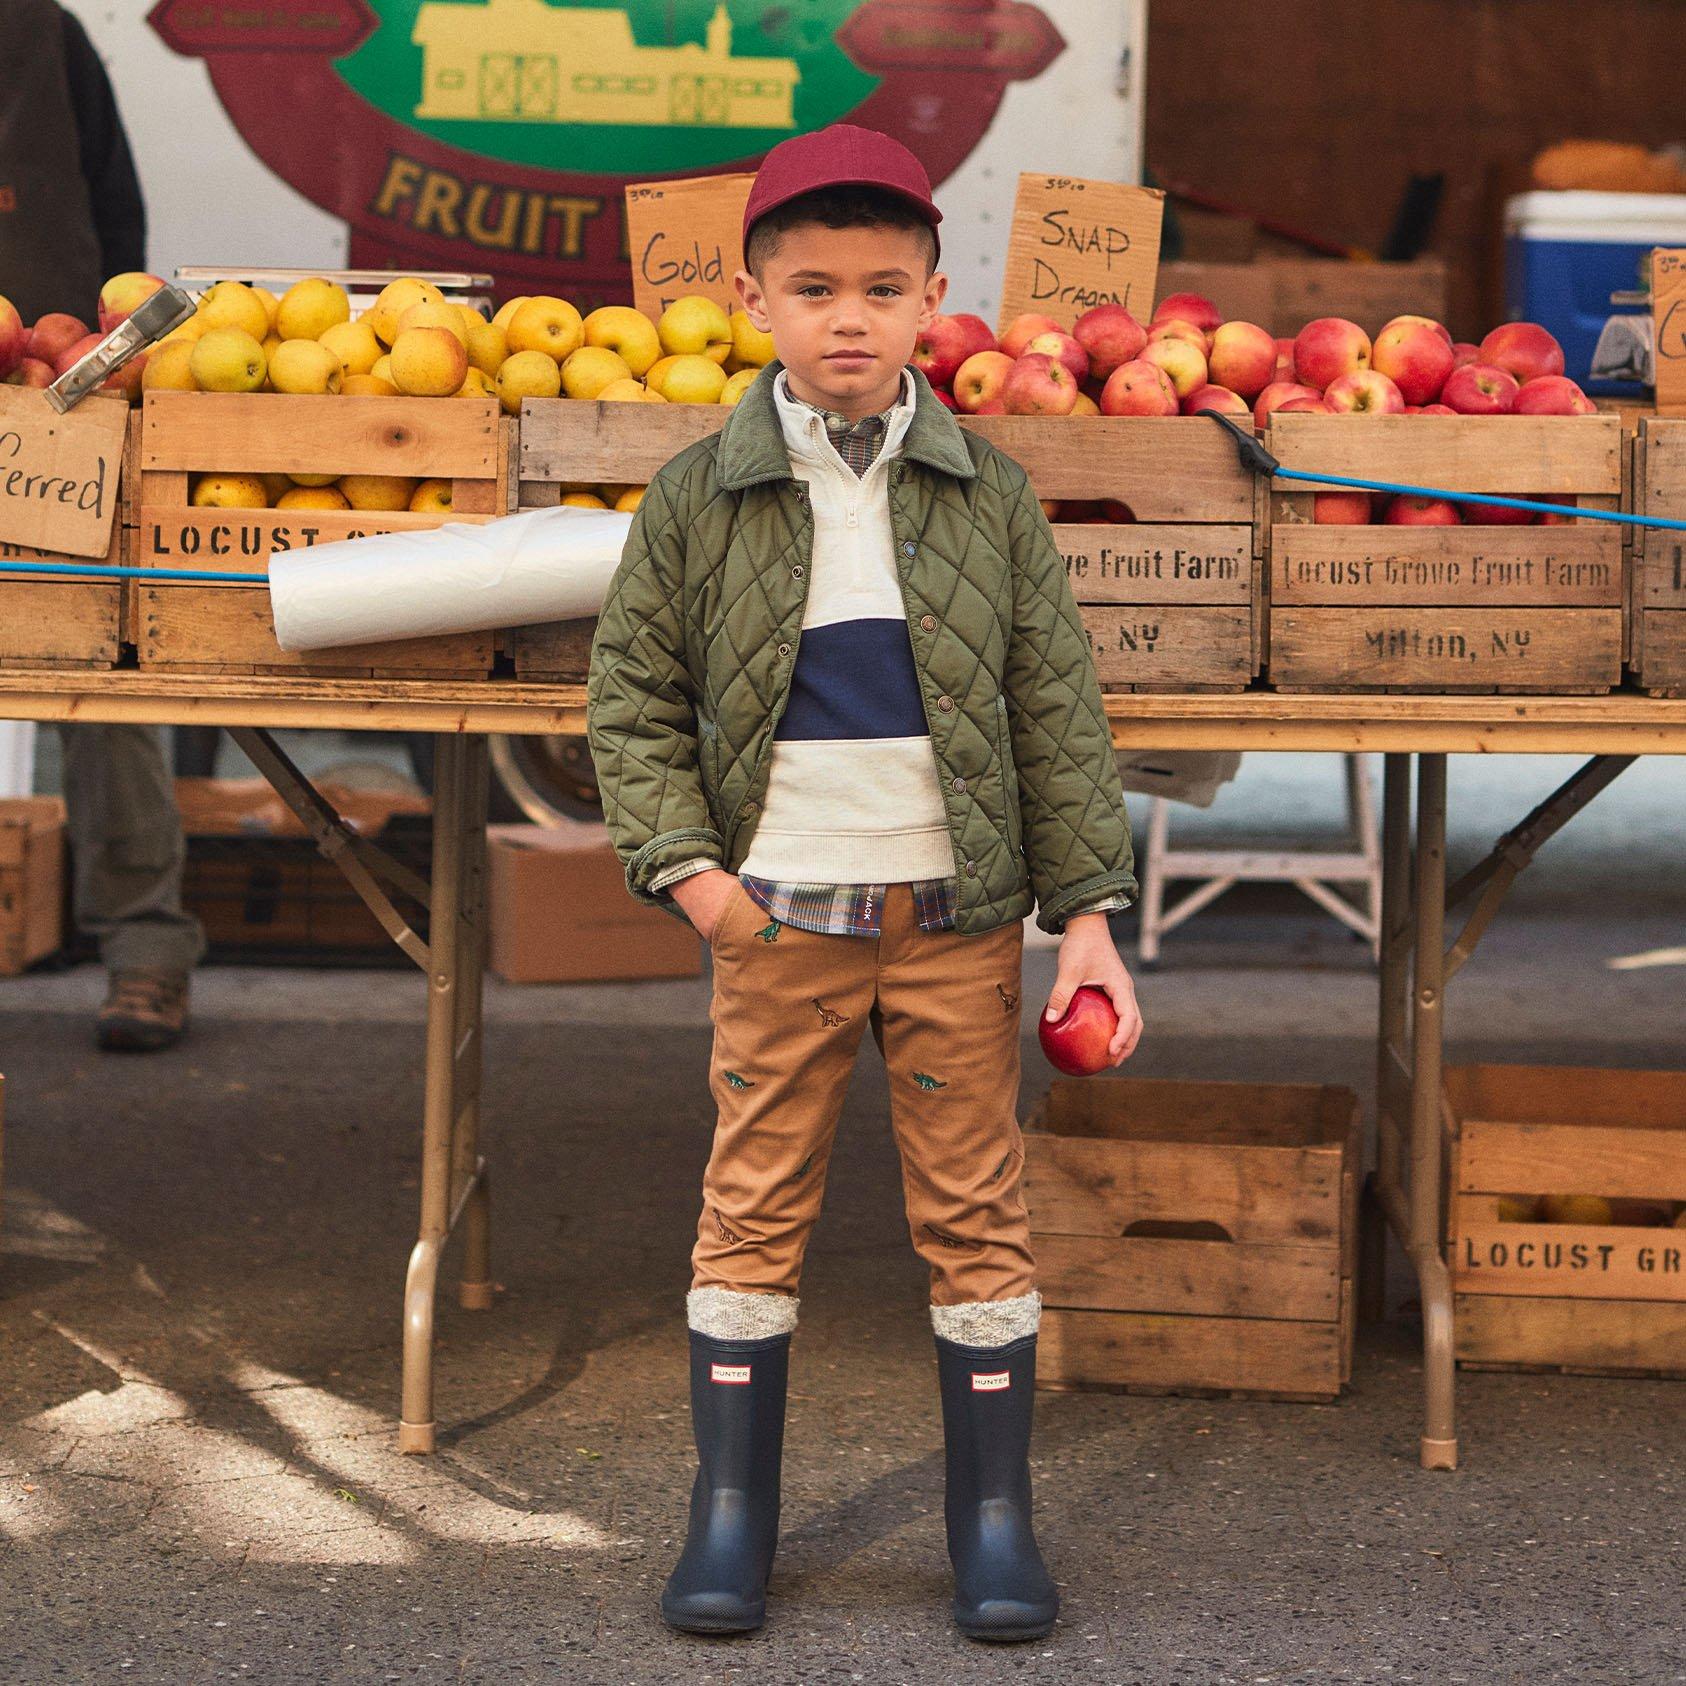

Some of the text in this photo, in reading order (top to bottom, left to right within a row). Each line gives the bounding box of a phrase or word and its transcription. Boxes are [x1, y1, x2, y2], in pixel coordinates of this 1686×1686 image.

[374, 153, 601, 257] FRUIT
[1041, 209, 1130, 271] SNAP
[642, 232, 724, 285] Gold
[153, 524, 319, 555] LOCUST
[1101, 549, 1163, 579] Fruit
[1174, 549, 1239, 579] Farm
[1284, 556, 1610, 588] Locust Grove Fruit Farm
[1120, 624, 1159, 652] NY
[1365, 629, 1530, 662] Milton, NY
[1466, 1238, 1614, 1271] LOCUST
[714, 1370, 748, 1378] HUNTER
[974, 1376, 1008, 1385] HUNTER
